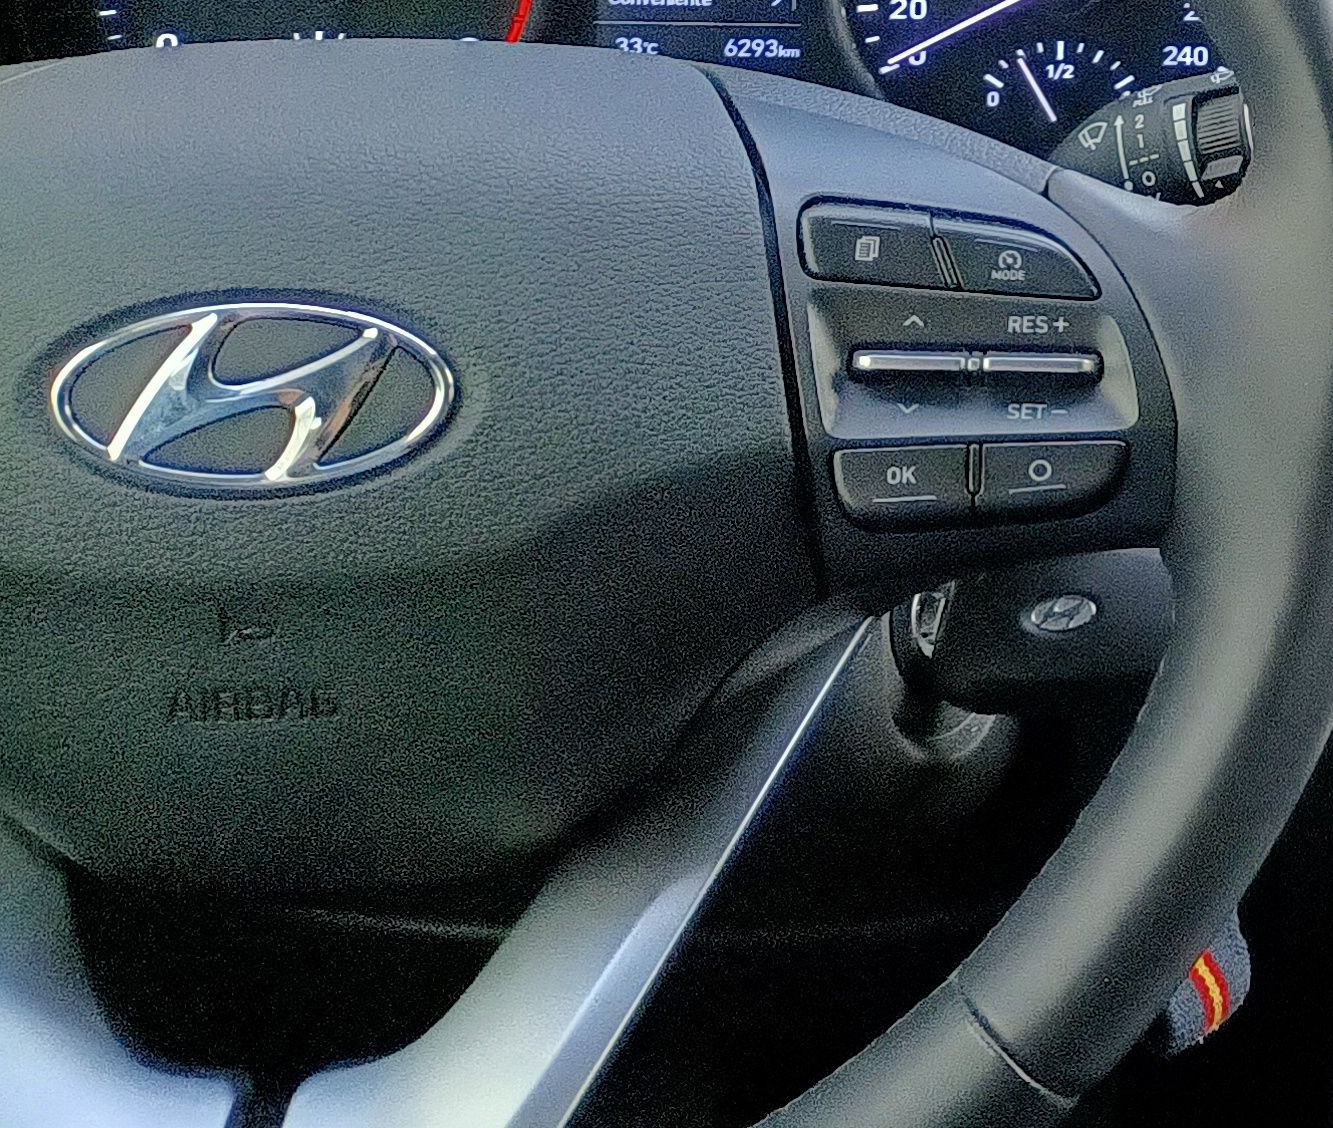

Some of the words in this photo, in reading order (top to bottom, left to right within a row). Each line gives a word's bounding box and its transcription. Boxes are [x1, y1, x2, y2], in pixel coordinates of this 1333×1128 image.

[1162, 45, 1209, 66] 240
[1045, 64, 1075, 80] 1/2
[986, 91, 1000, 107] 0
[1134, 114, 1145, 129] 2
[1137, 133, 1144, 148] 1
[990, 268, 1026, 282] MODE
[886, 466, 917, 486] OK
[168, 688, 338, 724] AIRBAG
